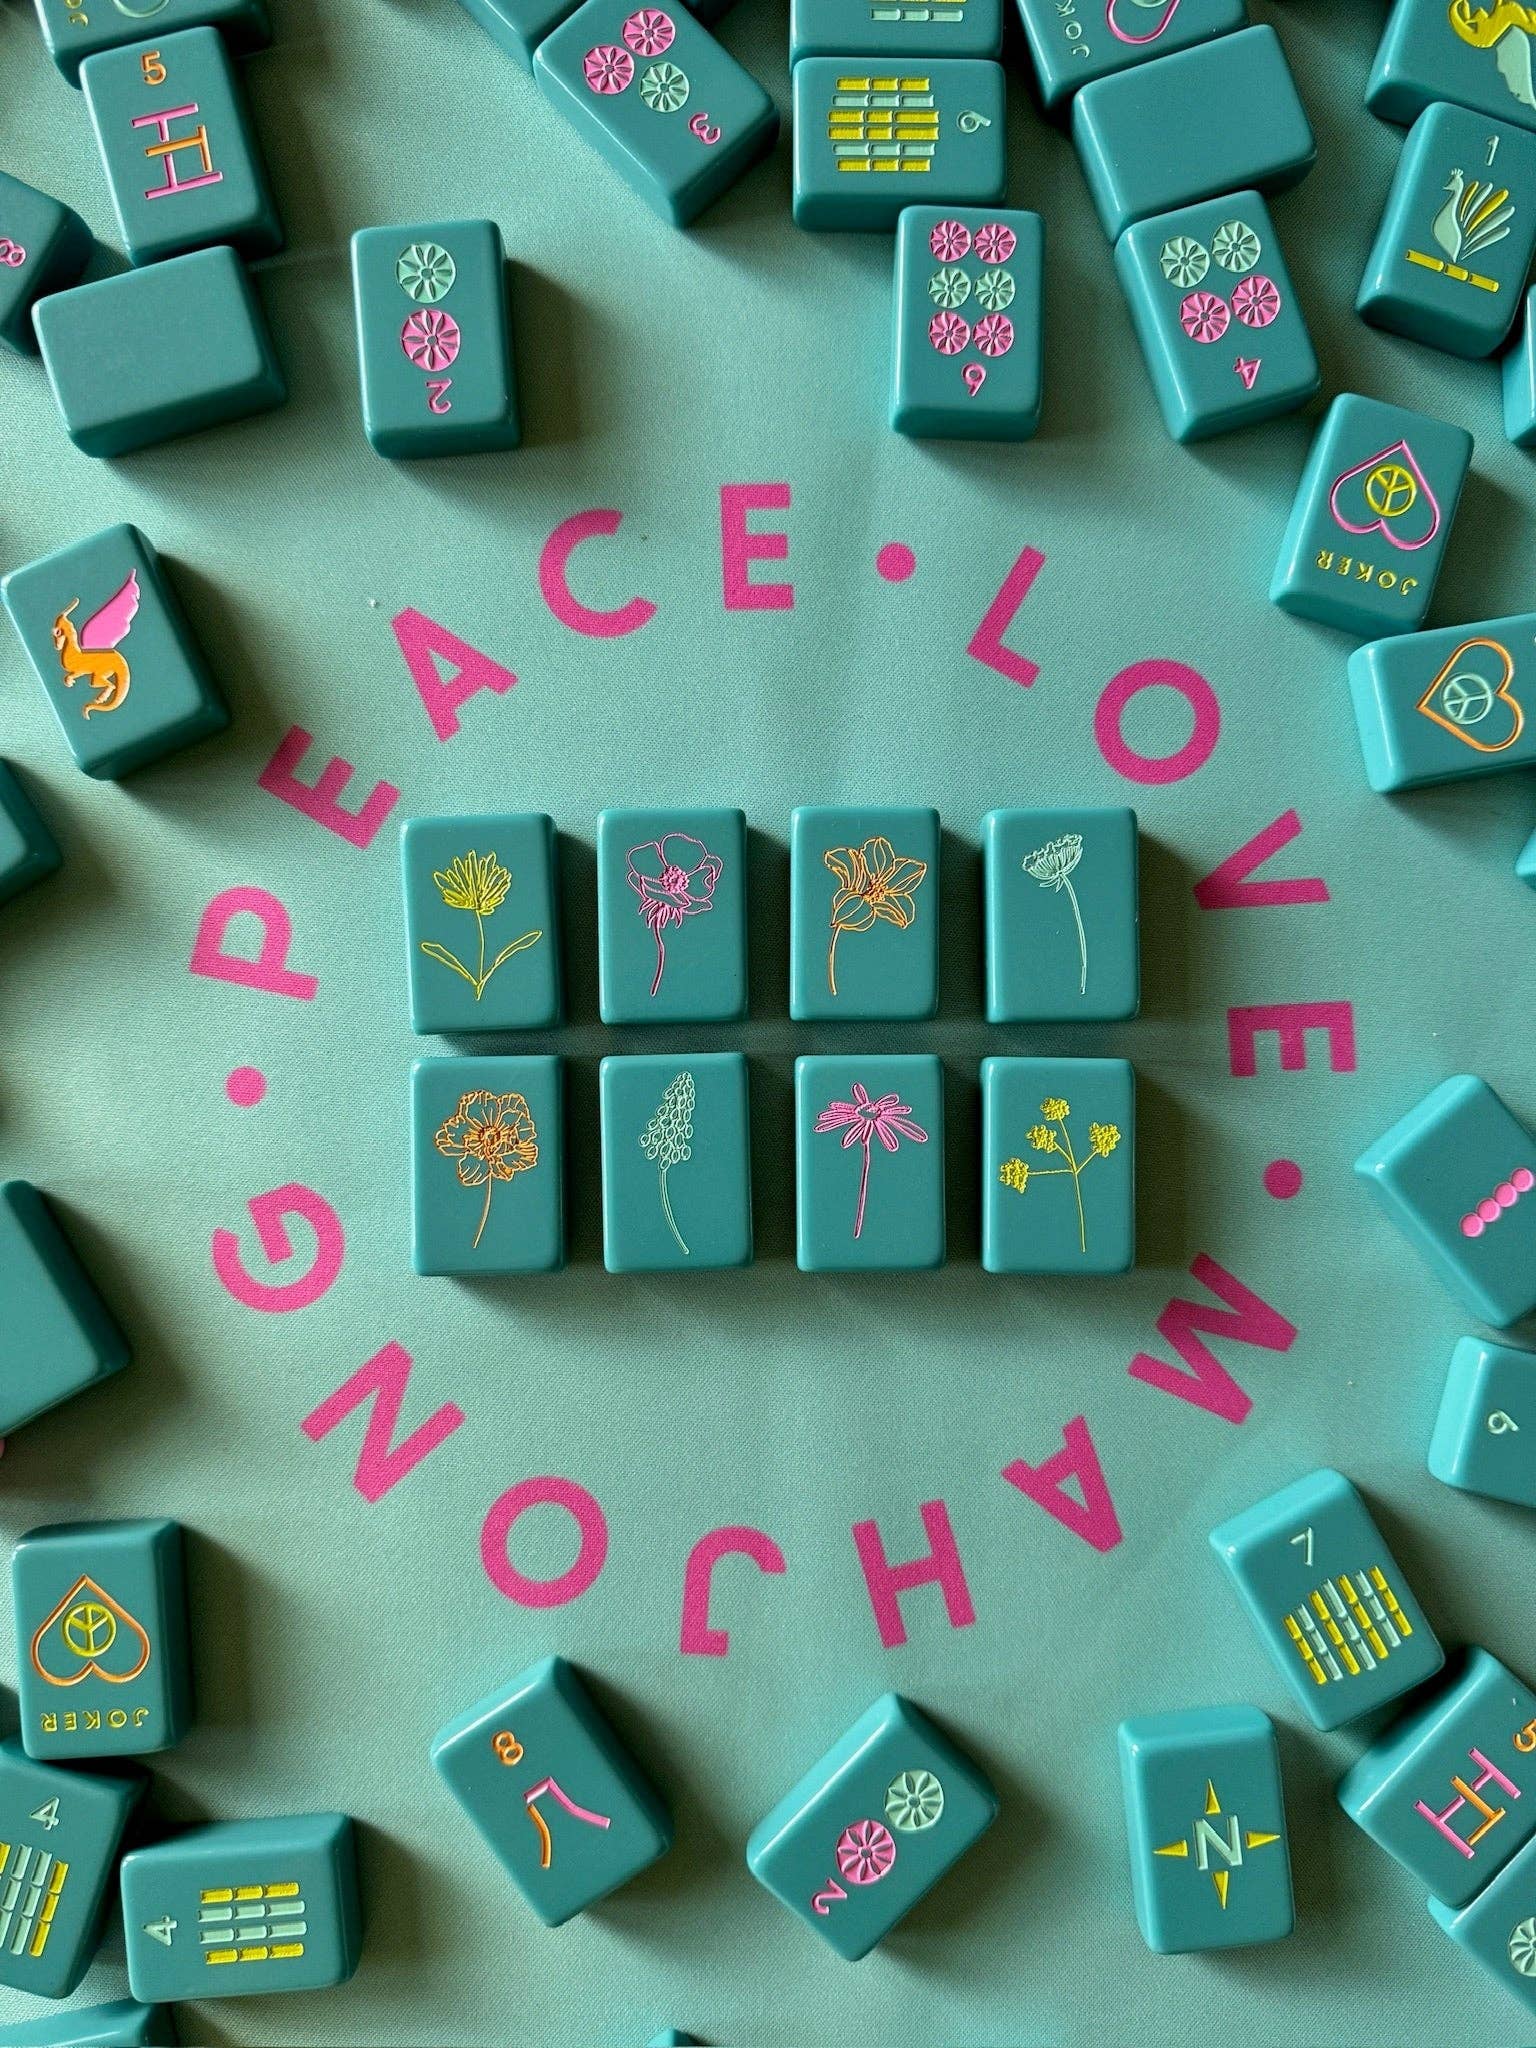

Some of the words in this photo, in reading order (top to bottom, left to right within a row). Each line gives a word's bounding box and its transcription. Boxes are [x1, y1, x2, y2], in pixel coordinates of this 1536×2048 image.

[141, 50, 167, 85] 5
[689, 113, 721, 145] 3
[1485, 134, 1500, 166] 1
[0, 237, 27, 268] 8
[961, 361, 987, 397] 6
[1233, 356, 1262, 390] 4
[425, 379, 453, 415] 2
[1315, 548, 1419, 597] JOKER
[190, 483, 793, 1000] PEACE
[967, 547, 1356, 1077] LOVE
[213, 1184, 1298, 1656] MAHJONG
[1290, 1526, 1314, 1566] 7
[40, 1707, 148, 1732] JOKER
[491, 1731, 524, 1766] 8
[30, 1797, 61, 1831] 4
[1195, 1814, 1243, 1870] N
[811, 1877, 847, 1915] 2
[143, 1915, 179, 1946] 4
